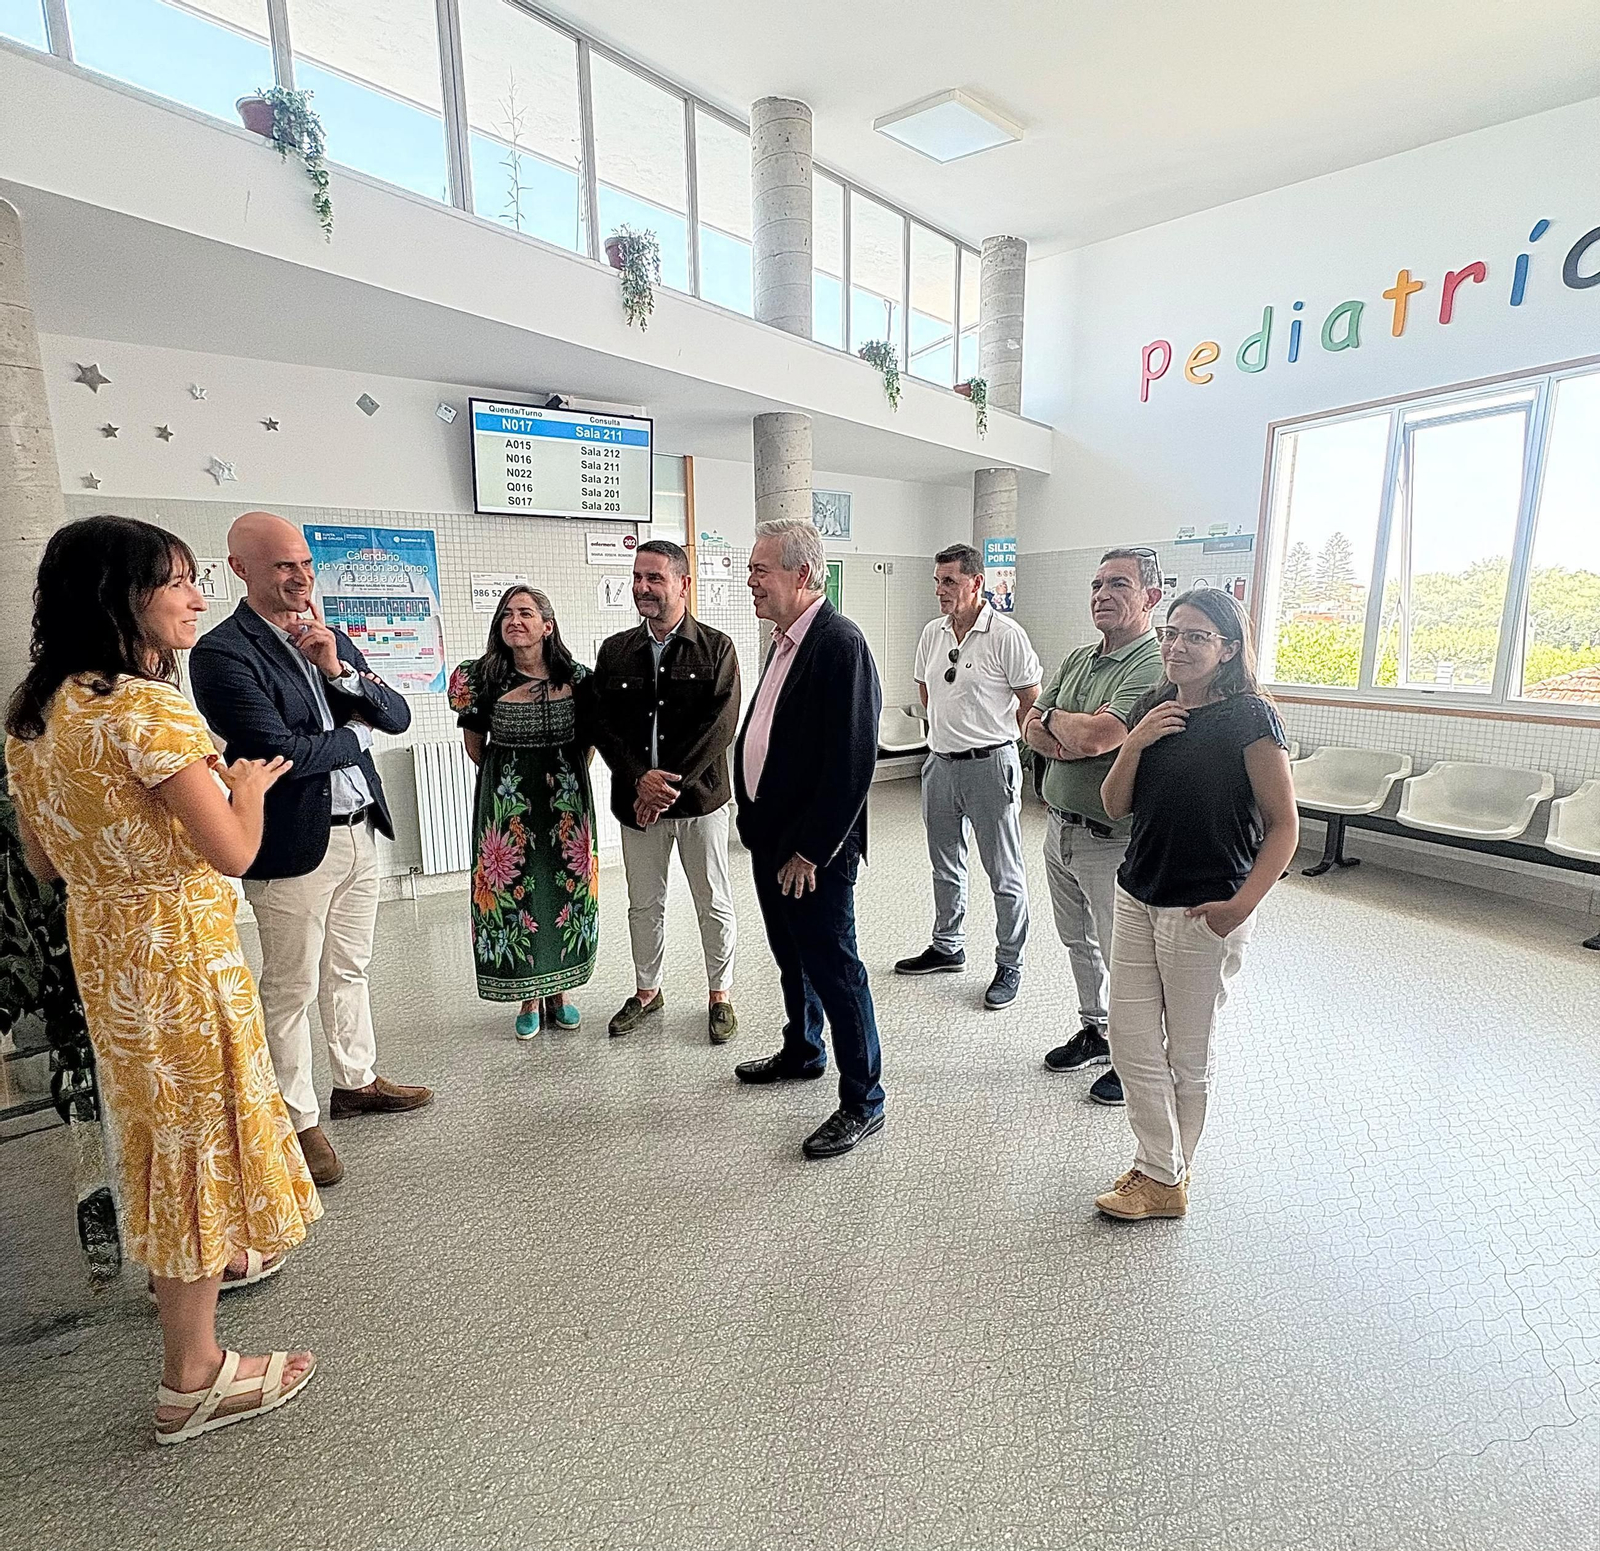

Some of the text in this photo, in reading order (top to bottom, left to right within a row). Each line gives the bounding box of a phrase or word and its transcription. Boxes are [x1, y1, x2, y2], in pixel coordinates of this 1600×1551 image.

[489, 405, 542, 418] Quenda/Turno
[502, 418, 532, 431] N017
[590, 417, 620, 426] Consulta
[576, 427, 622, 441] Sala 211
[505, 440, 531, 450] A015
[581, 447, 620, 458] Sala 212
[506, 454, 531, 464] N016
[581, 461, 620, 472] Sala 211
[507, 468, 532, 478] N022
[581, 474, 620, 485] Sala 211
[507, 482, 533, 492] Q016
[581, 488, 620, 498] Sala 201
[508, 496, 532, 506] S017
[582, 501, 620, 511] Sala 203
[347, 551, 400, 561] Calendario
[988, 554, 1004, 562] POR
[318, 560, 428, 574] de vacinación ao longo
[340, 572, 354, 582] de
[358, 573, 379, 583] toda
[390, 574, 410, 583] vida
[474, 589, 489, 597] 986
